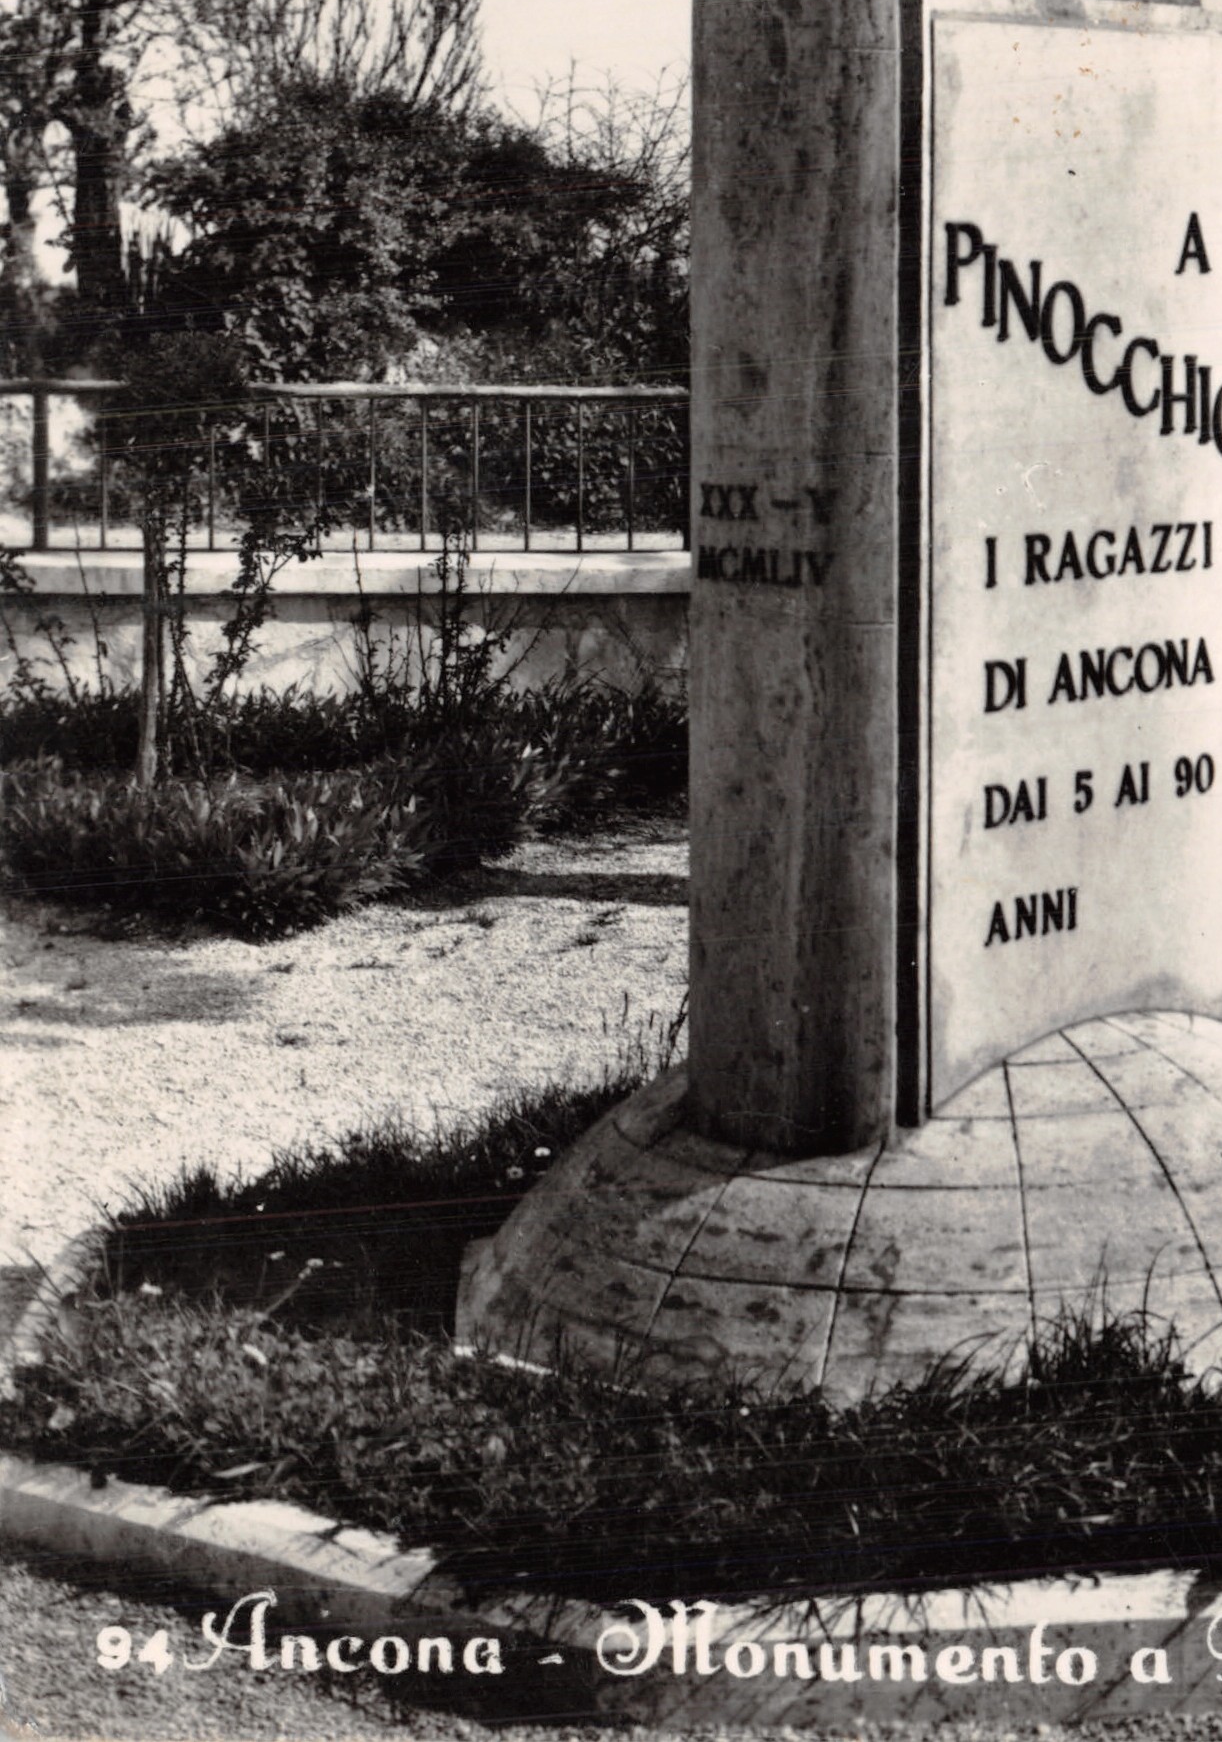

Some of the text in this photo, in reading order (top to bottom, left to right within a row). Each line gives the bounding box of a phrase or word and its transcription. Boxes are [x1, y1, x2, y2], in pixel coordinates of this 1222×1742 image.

[1174, 211, 1212, 275] A
[985, 521, 1212, 589] I RAGAZZI
[984, 637, 1215, 713] DI ANCONA
[984, 753, 1215, 829] DAI 5 AI 90
[984, 887, 1078, 948] ANNI
